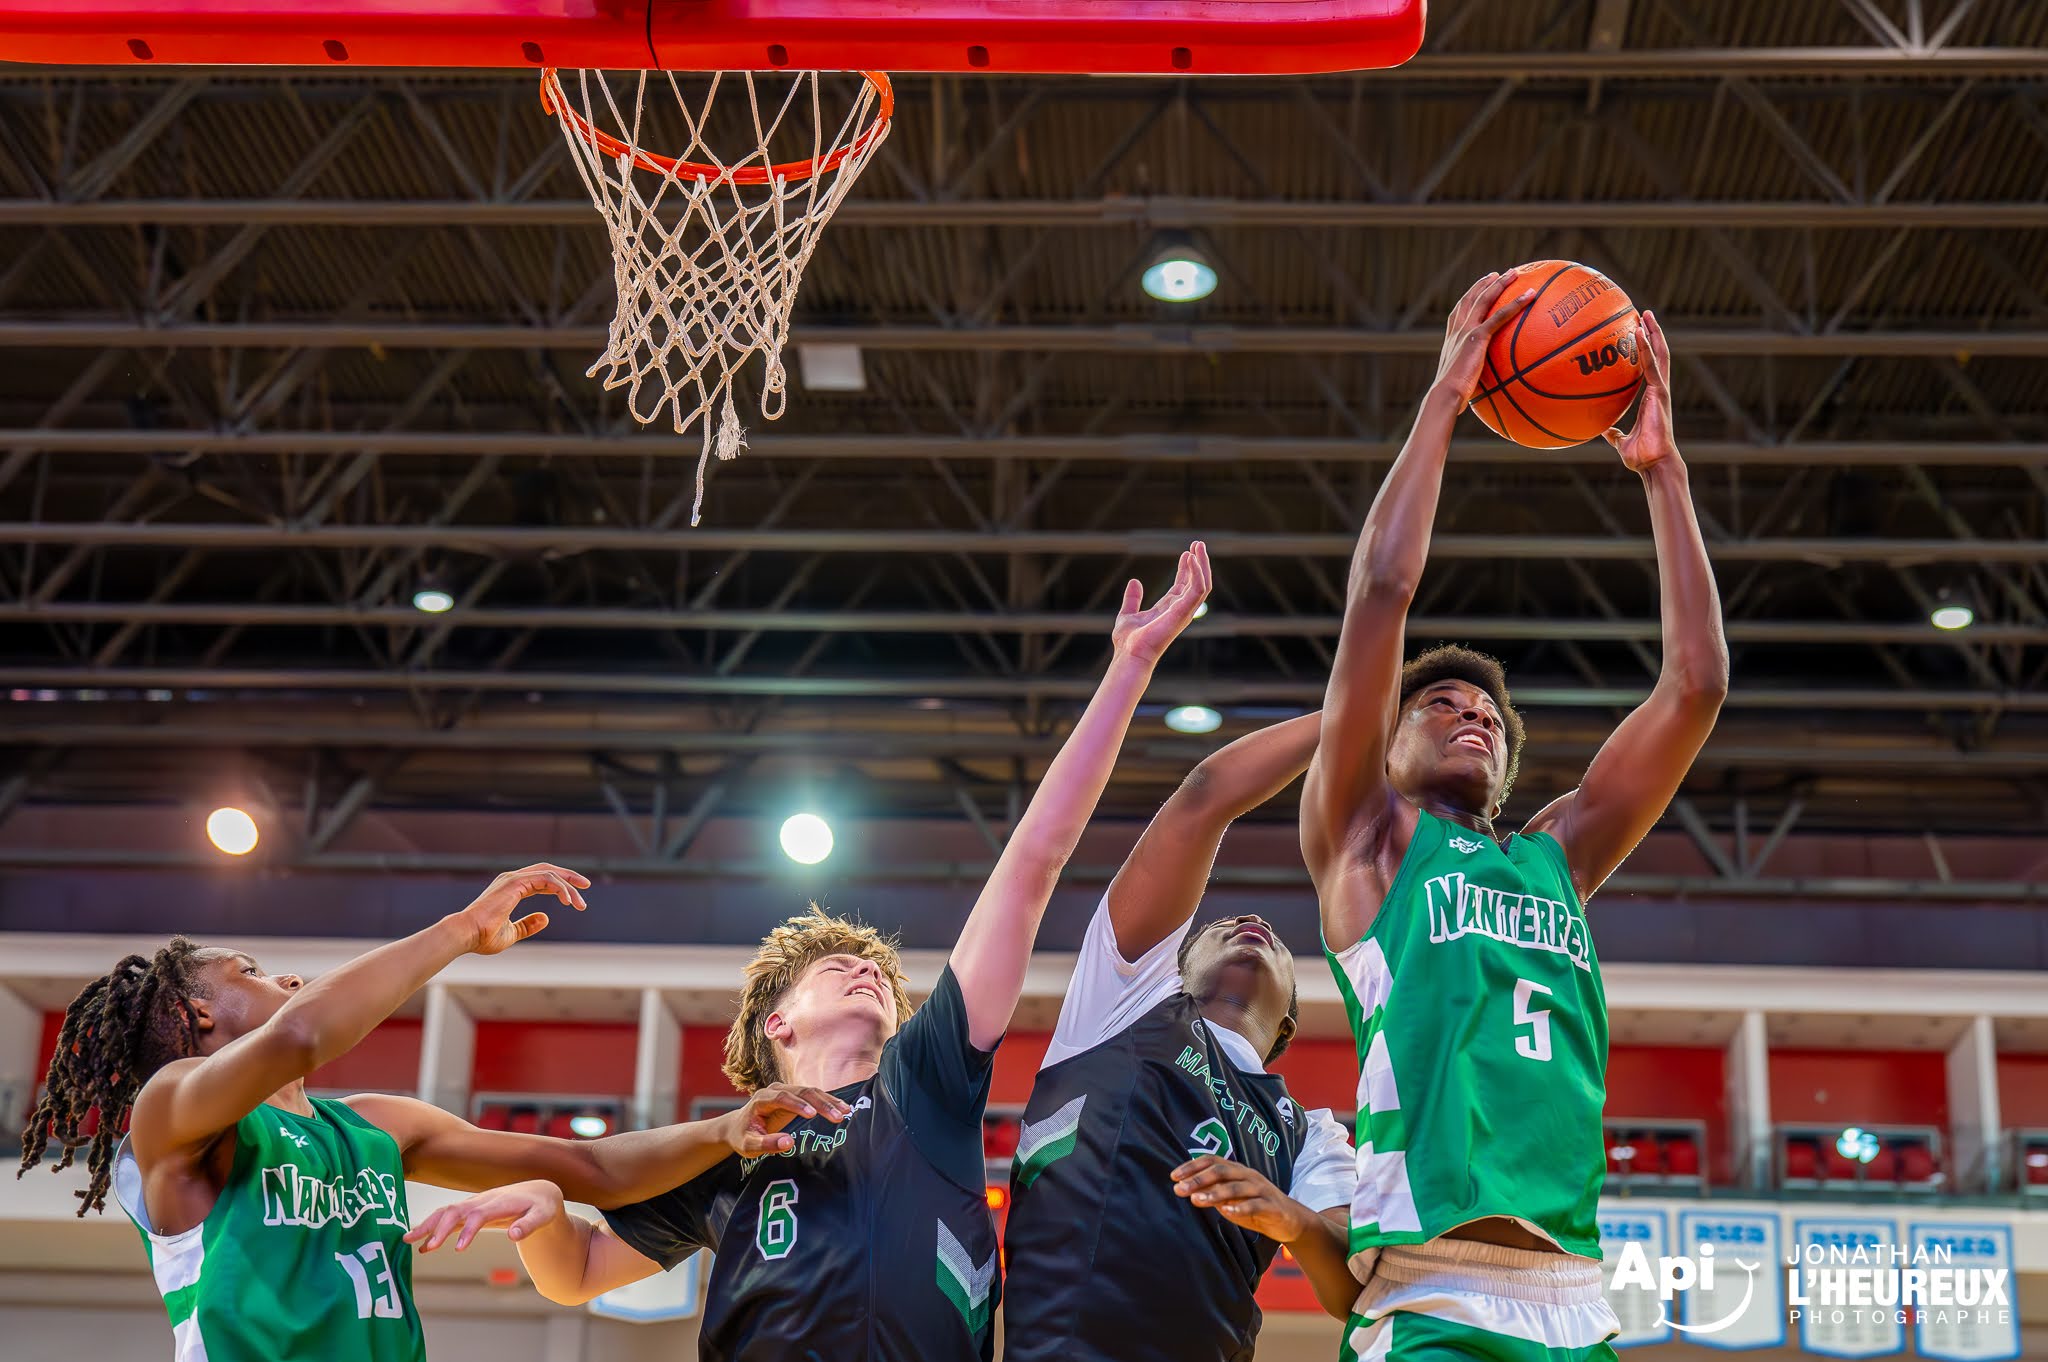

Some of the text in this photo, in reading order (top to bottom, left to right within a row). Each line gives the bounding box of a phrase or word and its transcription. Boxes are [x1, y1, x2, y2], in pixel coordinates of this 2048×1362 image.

[1449, 837, 1485, 854] PEAK
[1513, 978, 1553, 1062] 5
[1174, 1045, 1281, 1157] MAESTRO
[756, 1179, 799, 1261] 6
[334, 1241, 403, 1319] 13
